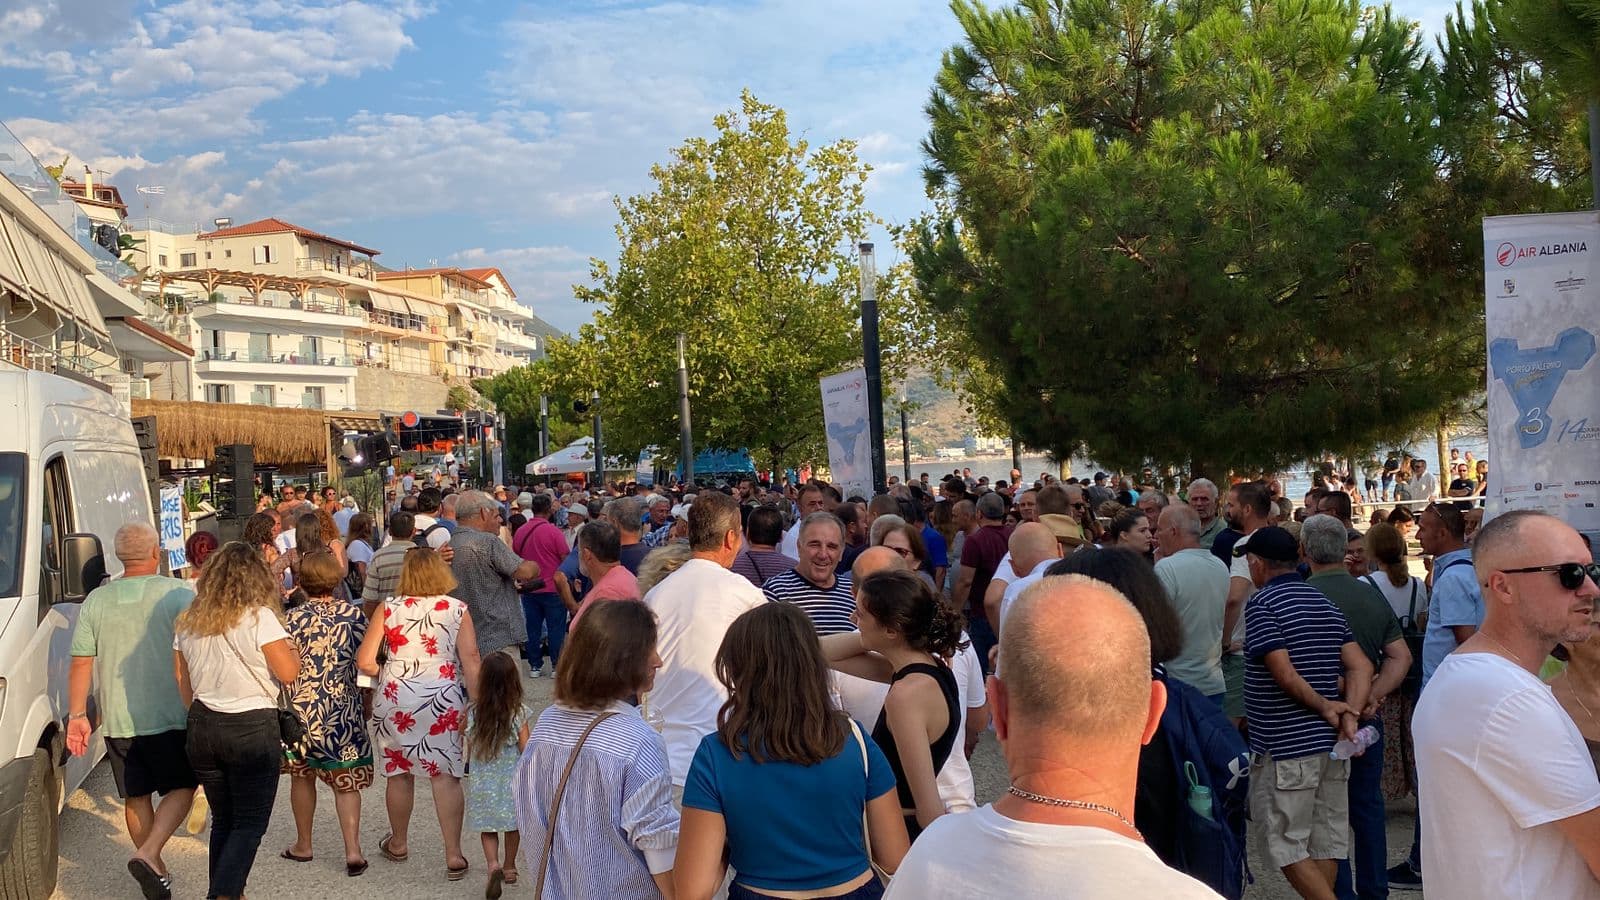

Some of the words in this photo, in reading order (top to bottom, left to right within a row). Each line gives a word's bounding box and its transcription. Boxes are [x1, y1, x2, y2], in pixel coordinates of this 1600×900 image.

[1517, 246, 1537, 259] AIR
[1539, 241, 1588, 257] ALBANIA
[1526, 407, 1543, 434] 3
[1557, 418, 1587, 443] 14
